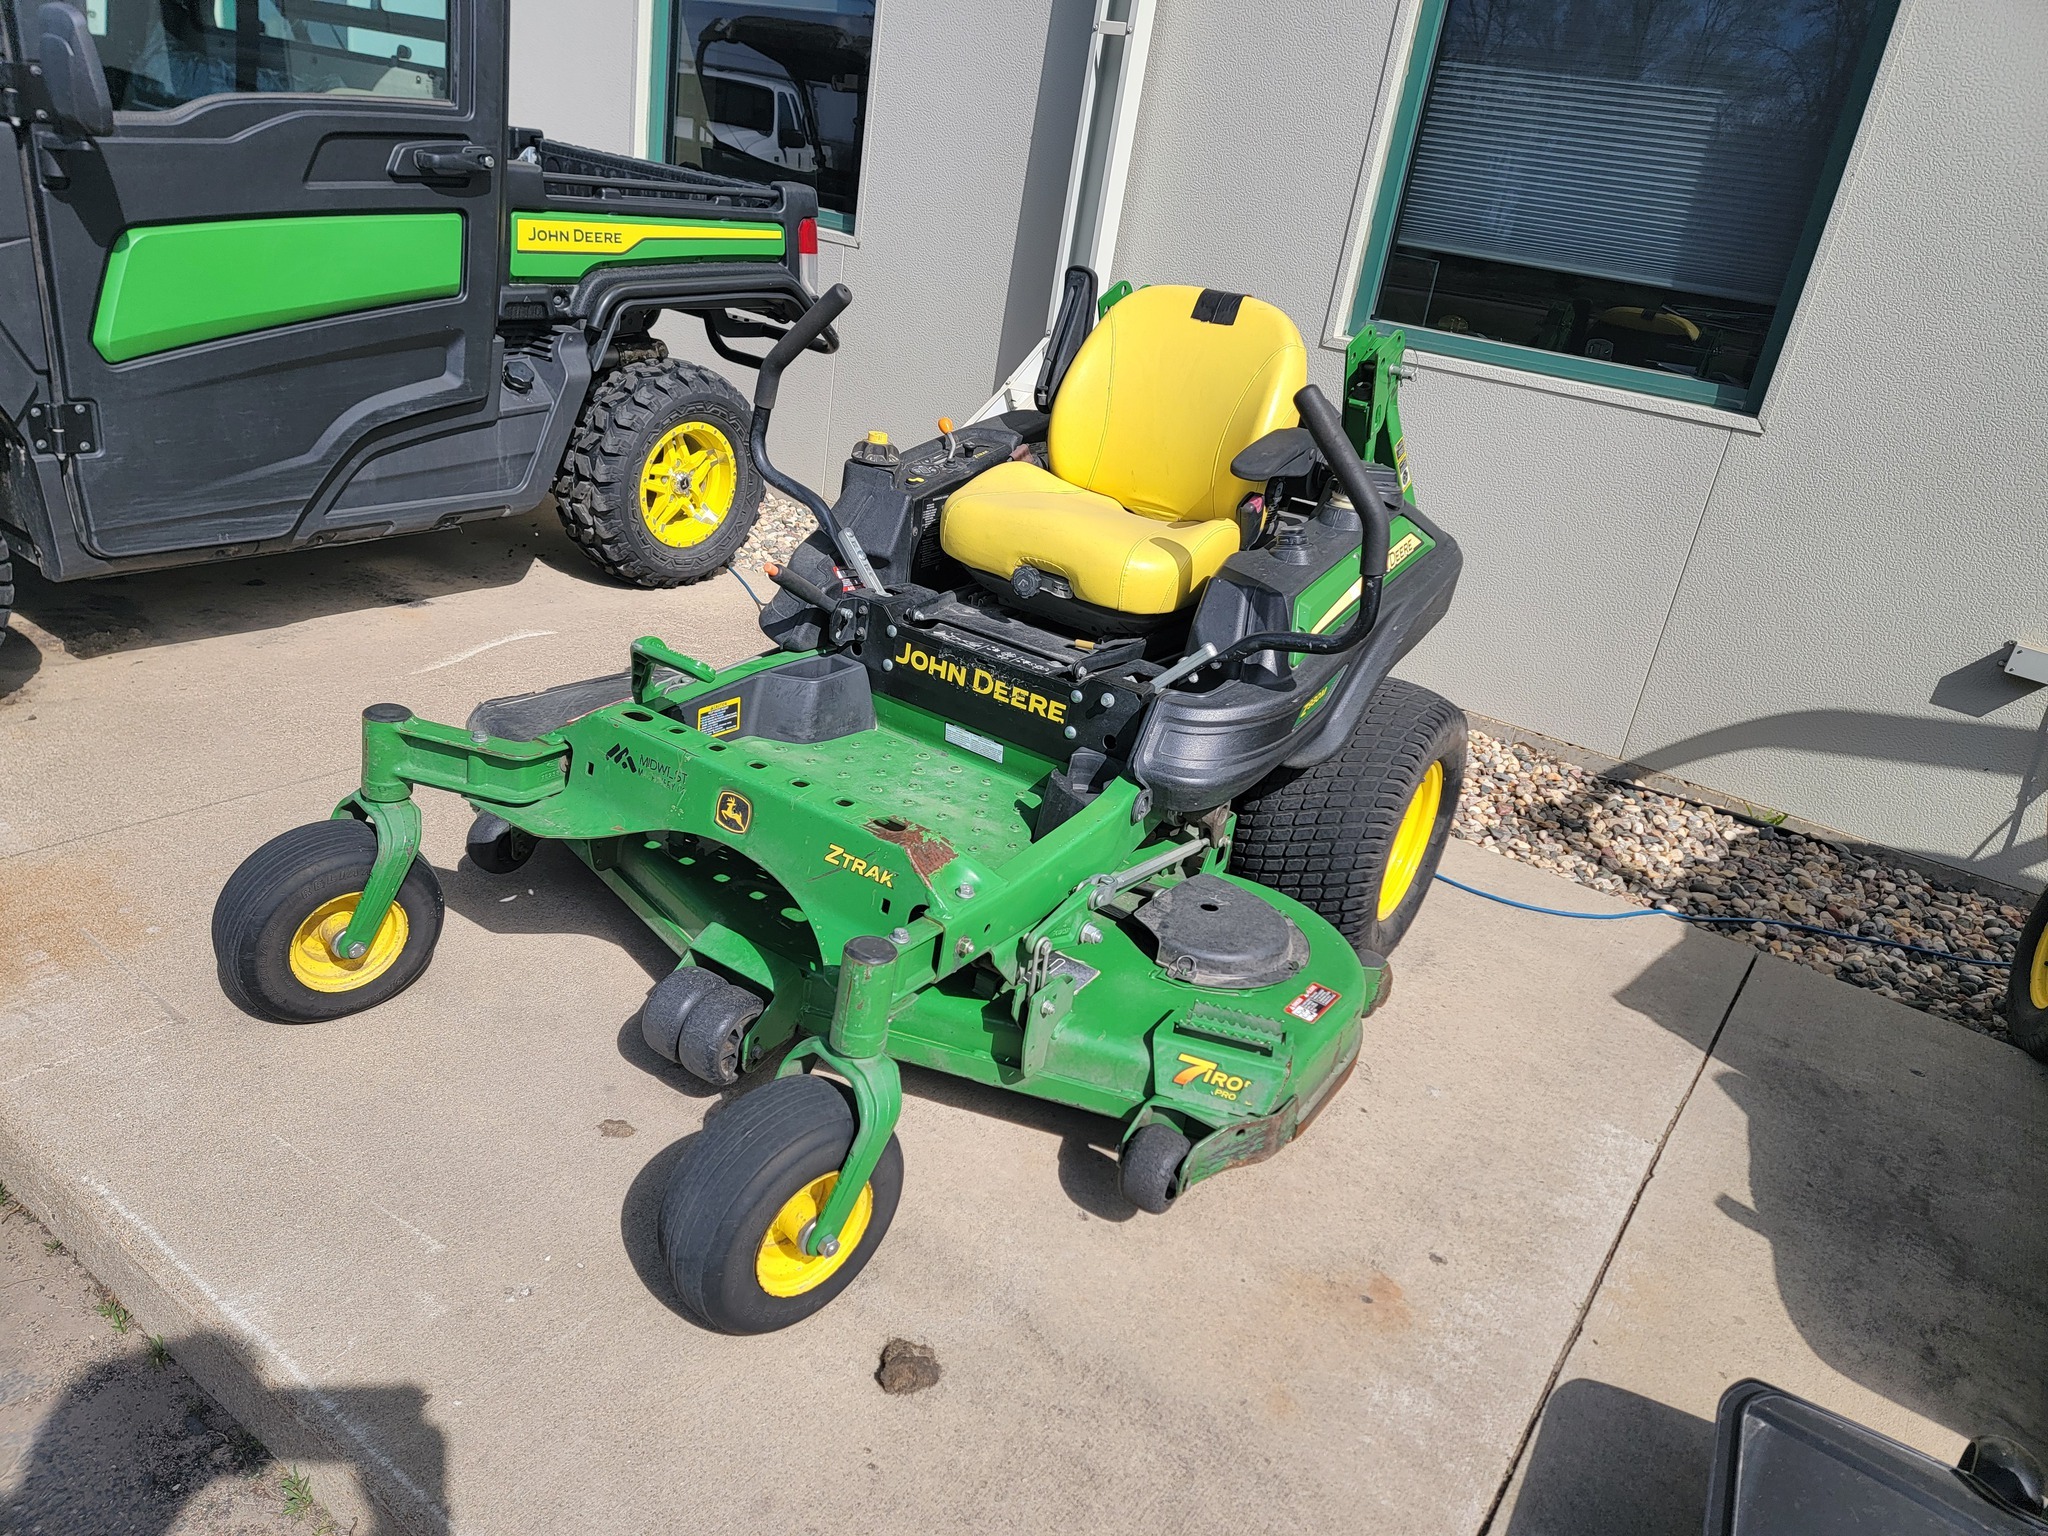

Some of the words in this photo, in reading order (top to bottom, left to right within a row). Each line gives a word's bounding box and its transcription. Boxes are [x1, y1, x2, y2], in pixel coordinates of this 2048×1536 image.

[528, 226, 570, 242] JOHN
[573, 228, 622, 244] DEERE
[1390, 539, 1412, 567] DEERE
[895, 642, 967, 687] JOHN
[972, 668, 1067, 724] DEERE
[823, 842, 895, 890] ZTRAK
[1214, 1087, 1238, 1102] PRO
